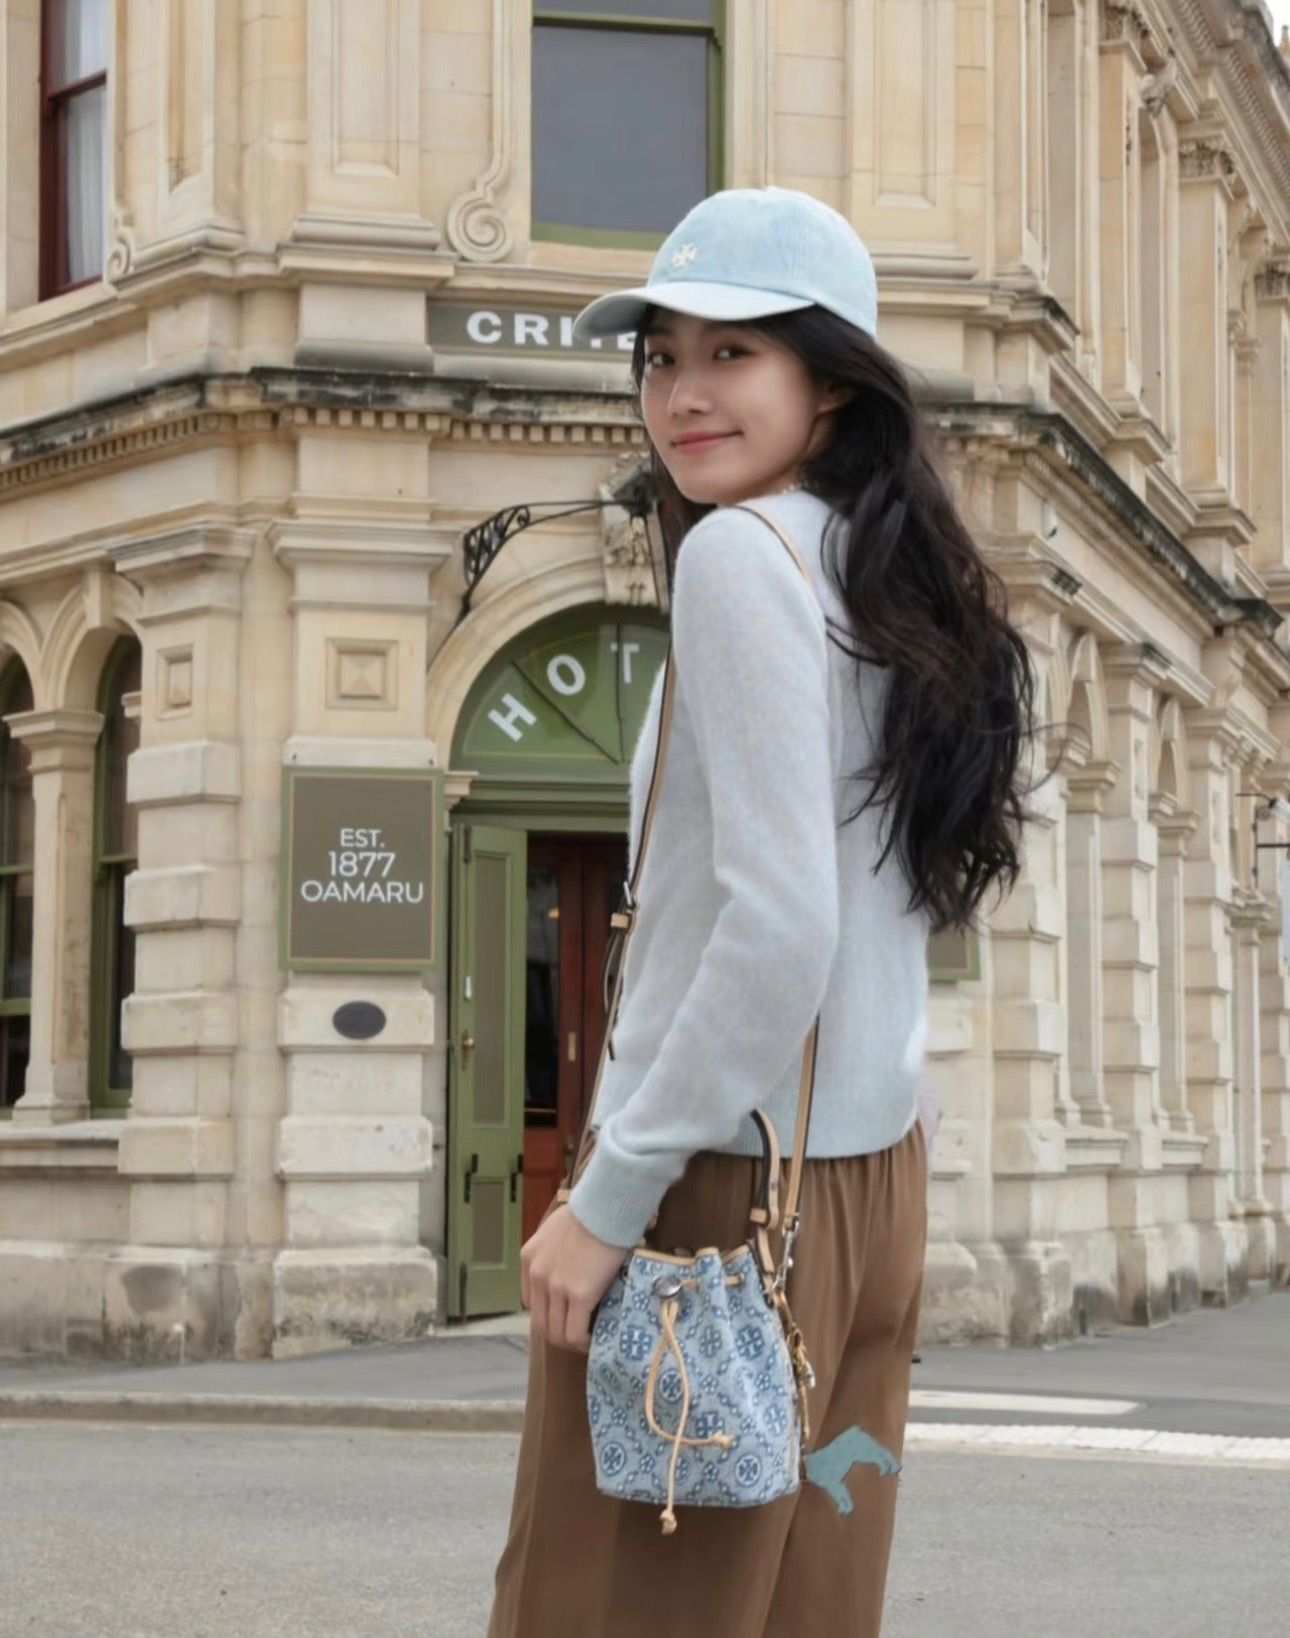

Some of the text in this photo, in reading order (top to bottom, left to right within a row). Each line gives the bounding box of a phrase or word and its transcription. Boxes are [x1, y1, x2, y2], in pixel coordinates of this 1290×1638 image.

[340, 827, 385, 848] EST.
[328, 850, 396, 877] 1877
[300, 879, 424, 904] OAMARU
